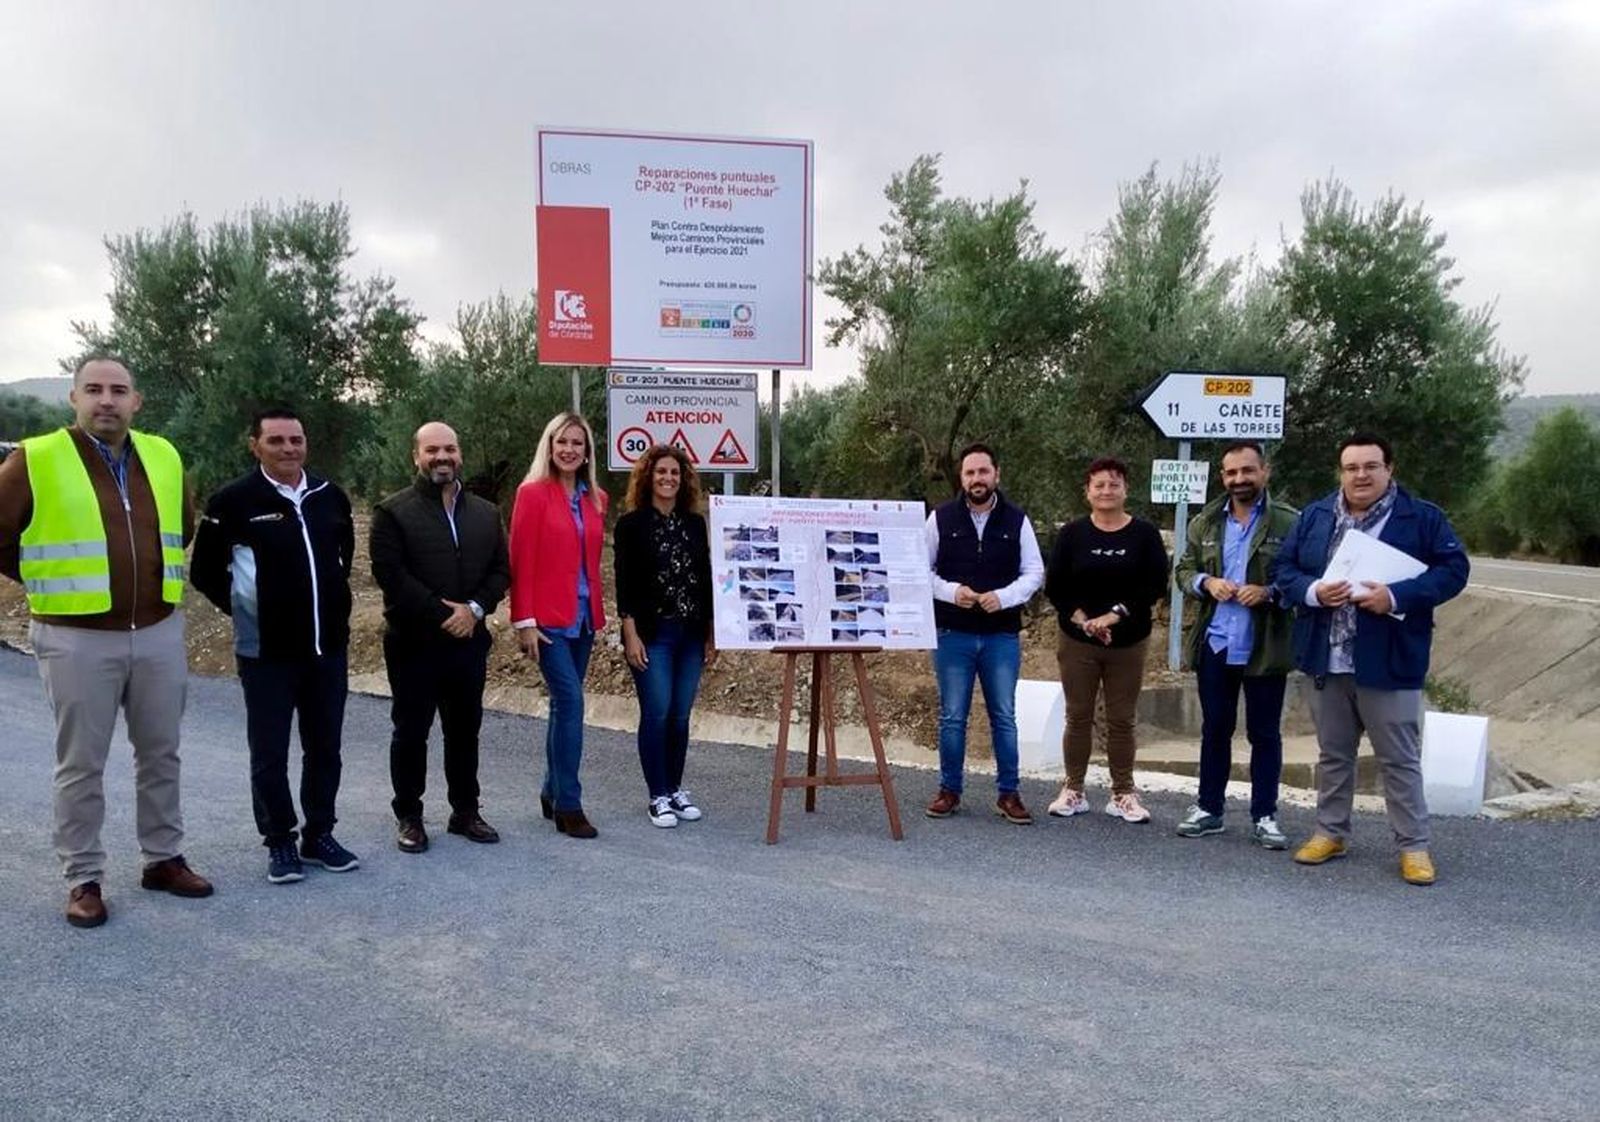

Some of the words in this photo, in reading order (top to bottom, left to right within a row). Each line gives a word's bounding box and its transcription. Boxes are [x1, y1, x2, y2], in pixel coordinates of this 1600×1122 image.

[550, 162, 591, 175] OBRAS
[639, 166, 717, 181] Reparaciones
[720, 171, 776, 183] puntuales
[635, 180, 675, 193] CP-202
[702, 197, 733, 211] Fase)
[651, 220, 670, 230] Plan
[671, 221, 699, 231] Contra
[700, 223, 765, 234] Despoblamiento
[650, 232, 678, 244] Mejora
[679, 234, 715, 243] Caminos
[716, 235, 765, 245] Provinciales
[665, 246, 683, 255] para
[685, 245, 693, 253] el
[694, 245, 728, 257] Ejercicio
[730, 246, 748, 256] 2021
[1206, 382, 1251, 393] CP-202
[625, 394, 671, 405] CAMINO
[673, 396, 741, 406] PROVINCIAL
[1167, 403, 1180, 416] 11
[1219, 401, 1281, 418] CAÑETE
[645, 409, 723, 424] ATENCIÓN
[1181, 422, 1196, 433] DE
[1204, 423, 1226, 433] LAS
[1234, 423, 1281, 433] TORRES
[626, 439, 646, 452] 30
[1160, 462, 1189, 472] COTO
